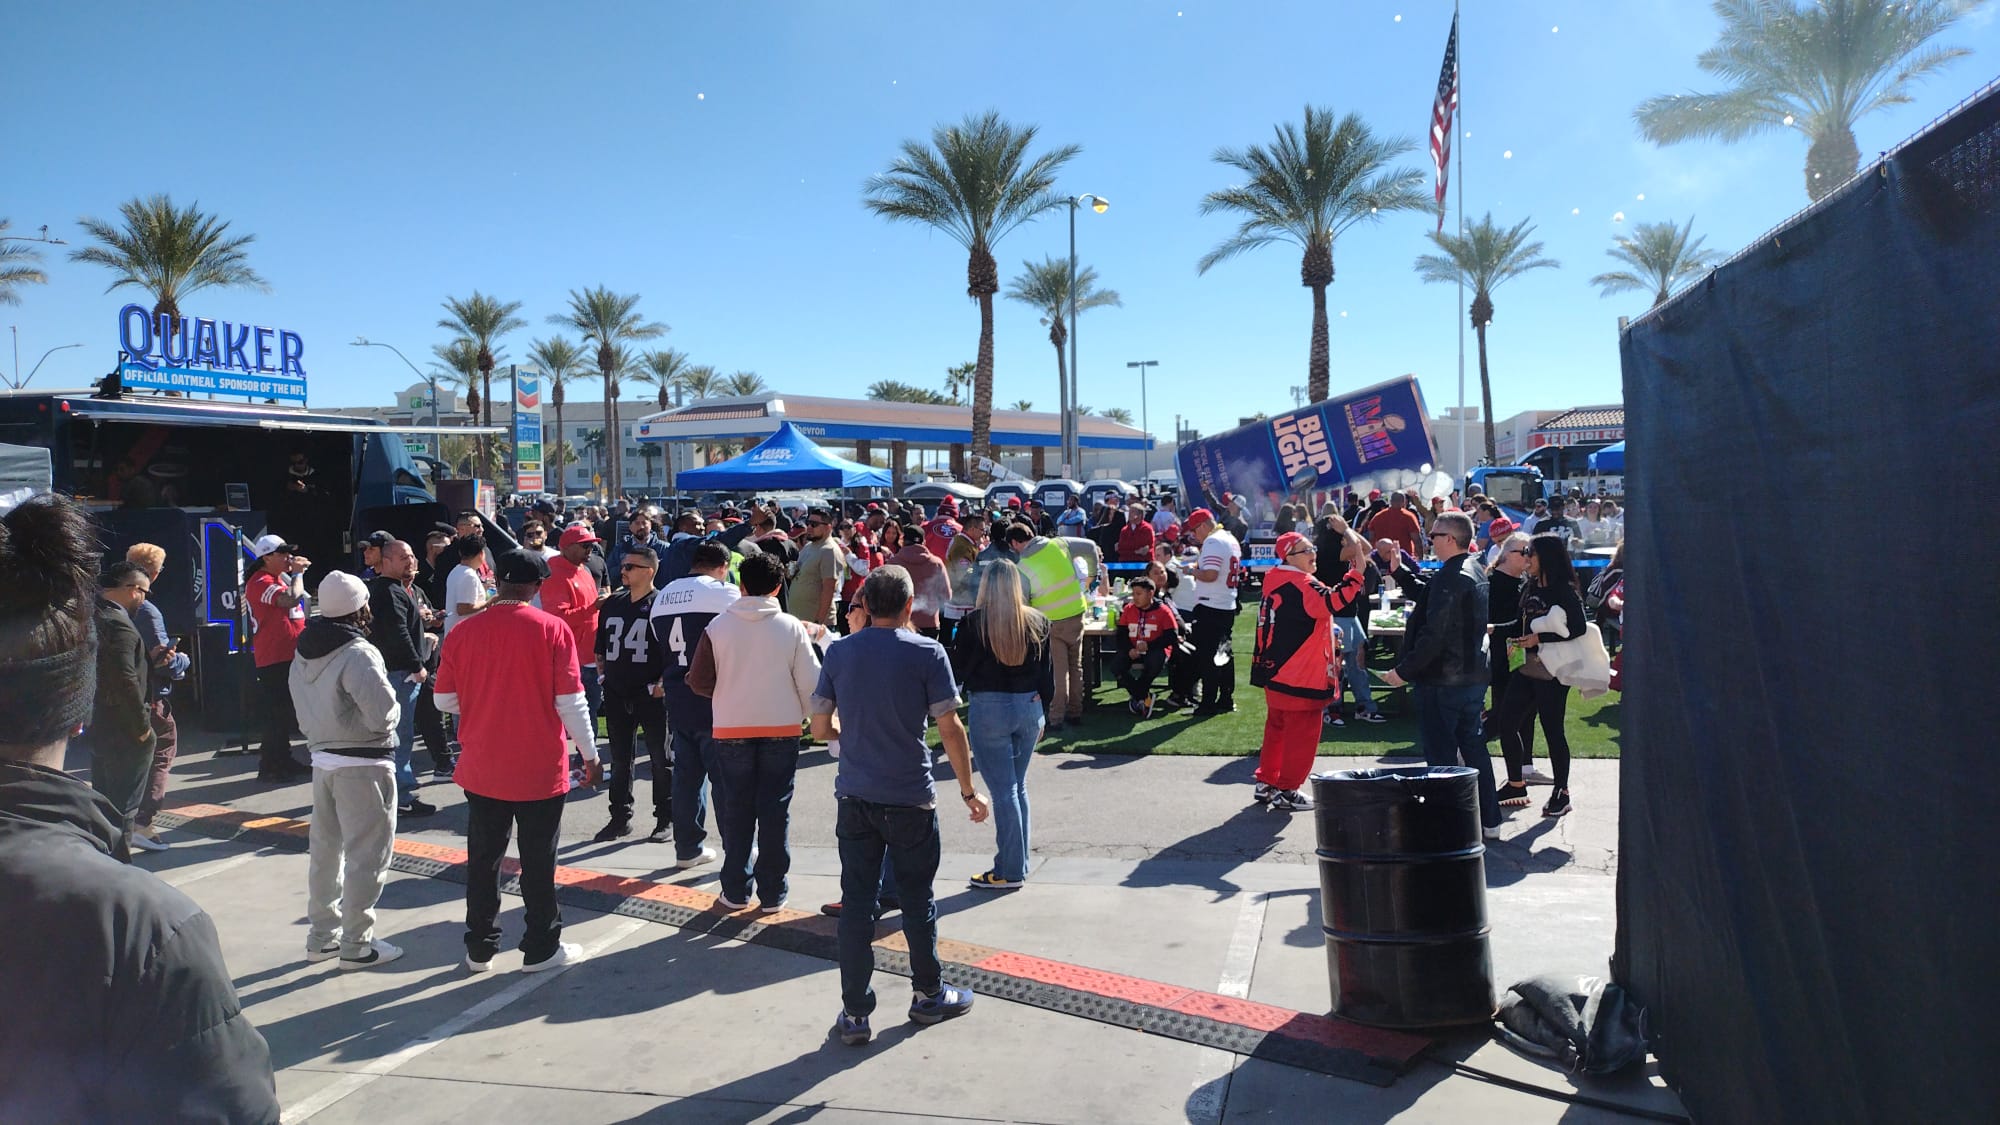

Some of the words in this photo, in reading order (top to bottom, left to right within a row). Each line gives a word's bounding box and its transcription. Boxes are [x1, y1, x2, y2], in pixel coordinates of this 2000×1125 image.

[119, 303, 306, 378] QUAKER
[124, 368, 170, 384] OFFICIAL
[171, 373, 216, 388] OATMEAL
[219, 378, 259, 392] SPONSOR
[260, 381, 271, 392] OF
[272, 383, 289, 395] THE
[290, 385, 306, 396] NFL
[1272, 414, 1309, 487] LIGH
[1297, 414, 1333, 475] BUD
[1255, 547, 1271, 556] FOR
[660, 590, 694, 606] ANGELES
[605, 616, 649, 663] 34
[668, 616, 688, 667] 4
